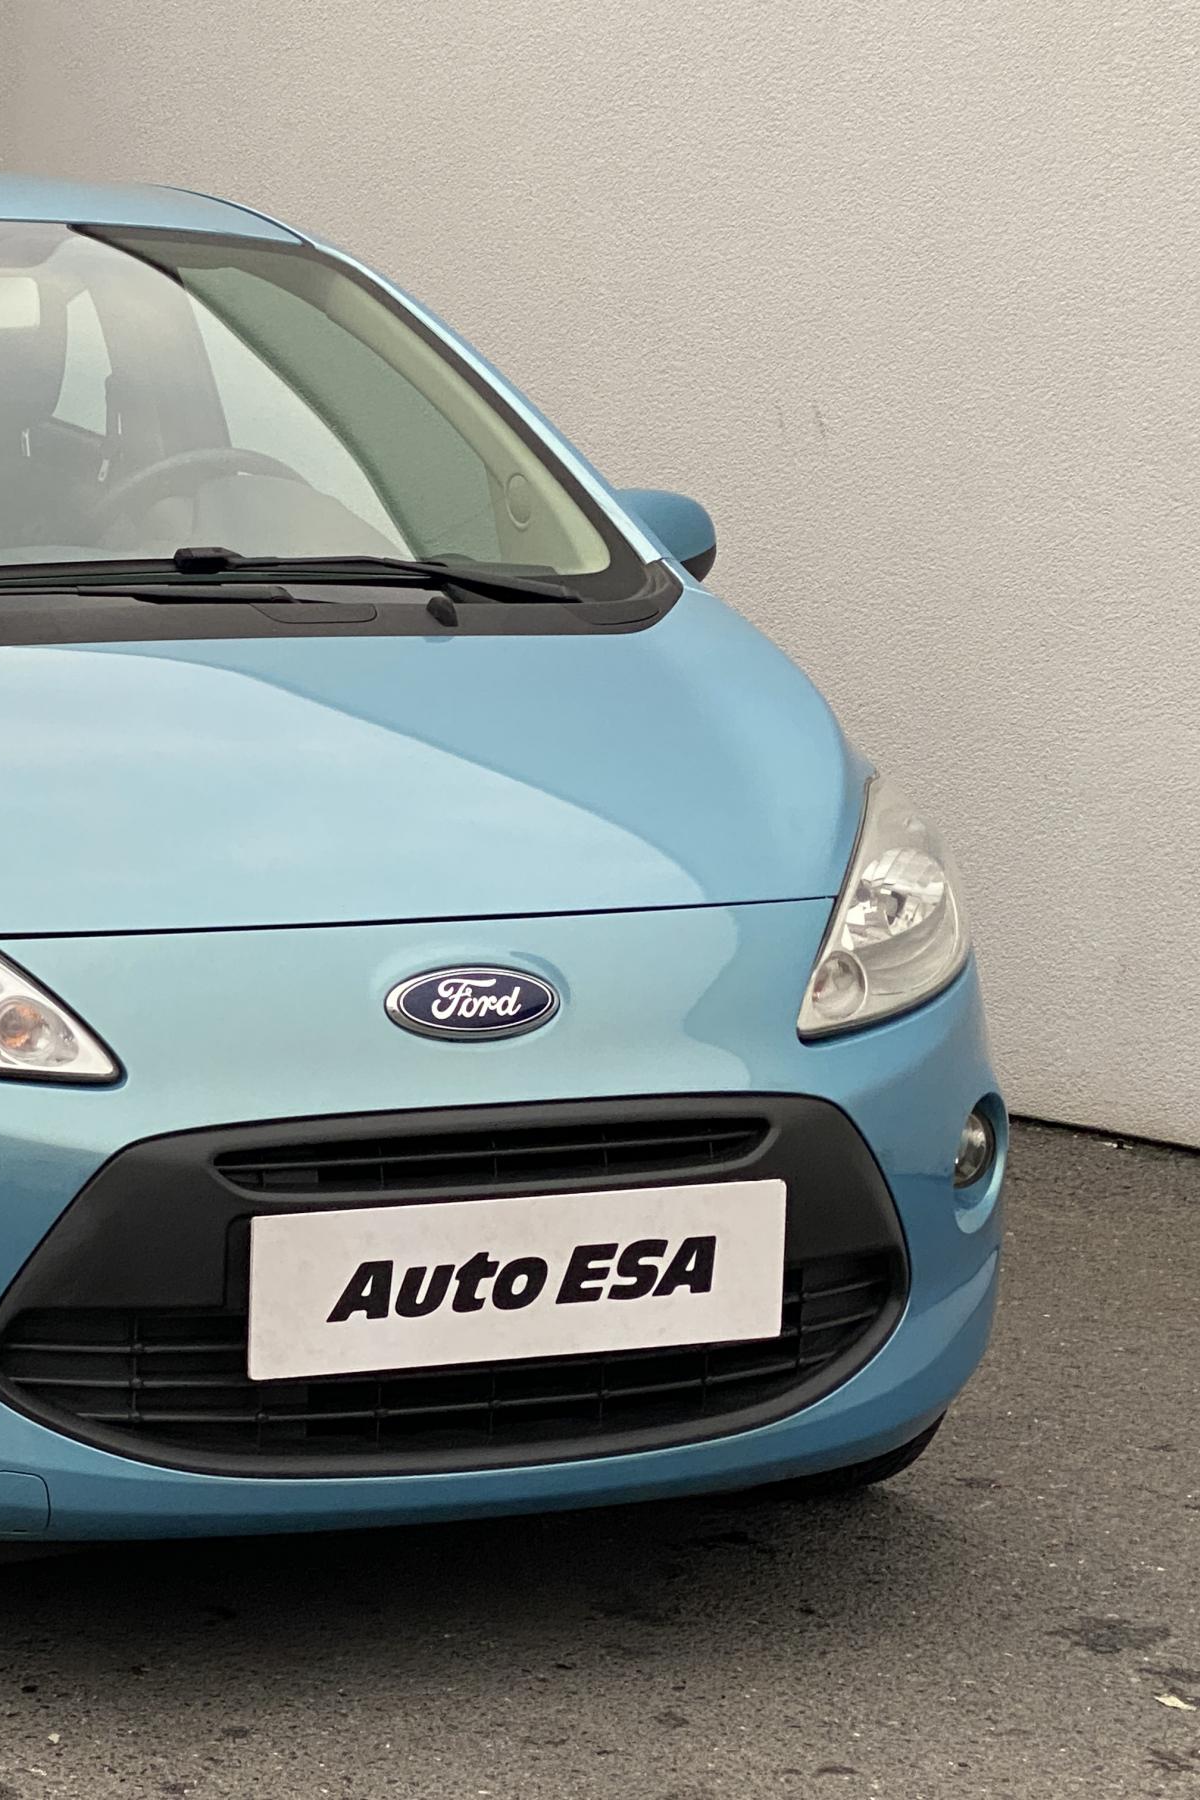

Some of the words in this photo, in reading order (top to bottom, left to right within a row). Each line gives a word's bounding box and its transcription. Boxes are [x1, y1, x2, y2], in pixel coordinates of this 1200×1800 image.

[431, 978, 521, 1019] Ford
[326, 1252, 548, 1322] Auto
[555, 1236, 717, 1304] ESA
